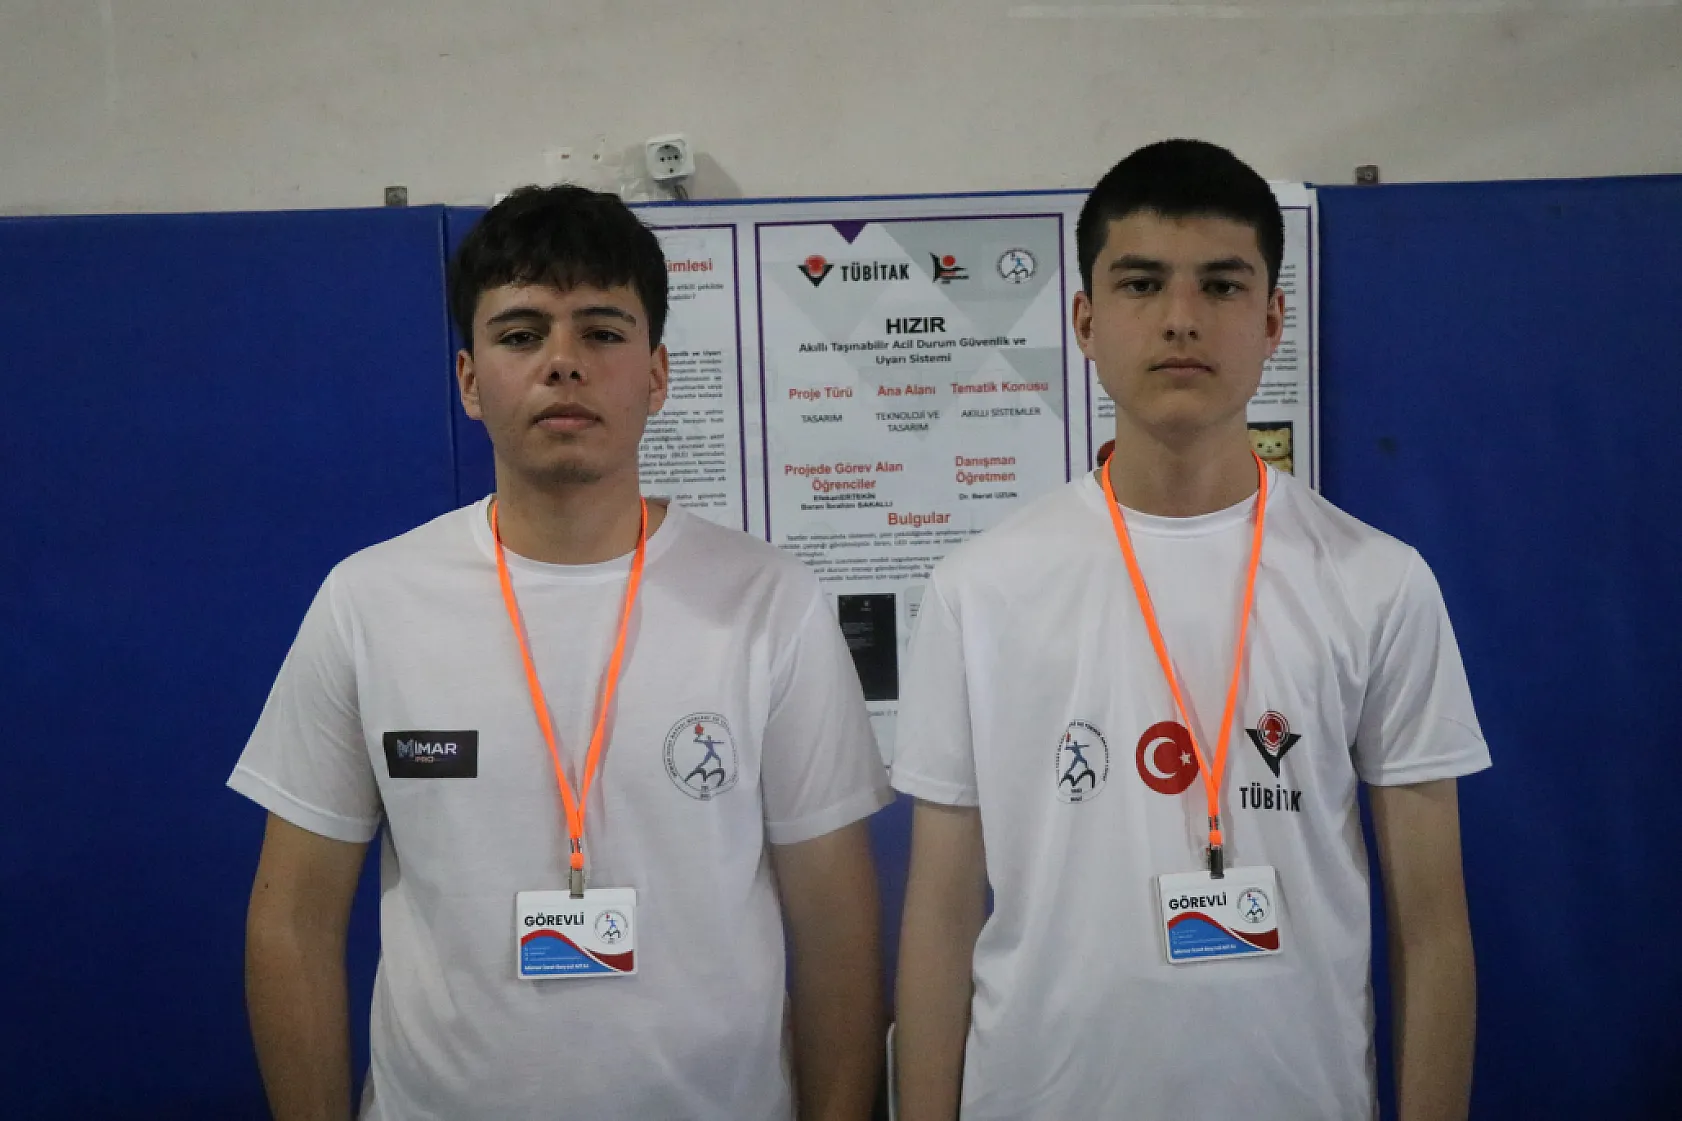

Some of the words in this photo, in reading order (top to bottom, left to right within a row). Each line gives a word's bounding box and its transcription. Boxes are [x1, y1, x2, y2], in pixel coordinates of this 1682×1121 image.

[665, 258, 713, 272] ümlesi
[841, 261, 910, 282] TÜBİTAK
[886, 317, 946, 334] HIZIR
[799, 342, 828, 353] Akıllı
[832, 340, 889, 353] Taşınabilir
[892, 339, 913, 349] Acil
[916, 338, 956, 349] Durum
[959, 336, 1009, 348] Güvenlik
[1012, 337, 1027, 346] ve
[876, 354, 906, 366] Uyarı
[909, 353, 951, 363] Sistemi
[789, 389, 821, 401] Proje
[824, 386, 853, 398] Türü
[877, 386, 903, 397] Ana
[905, 385, 936, 396] Alanı
[950, 383, 997, 394] Tematik
[1001, 381, 1049, 392] Konusu
[801, 414, 843, 423] TASARIM
[927, 410, 940, 419] VE
[888, 423, 929, 432] TASARIM
[784, 464, 832, 476] Projede
[834, 462, 872, 474] Görev
[875, 461, 903, 472] Alan
[955, 456, 1016, 468] Danışman
[812, 479, 877, 491] Öğrenciler
[955, 471, 1016, 485] Öğretmen
[888, 511, 951, 528] Bulgular
[1169, 891, 1227, 911] GÖREVLİ
[524, 911, 584, 927] GÖREVLİ
